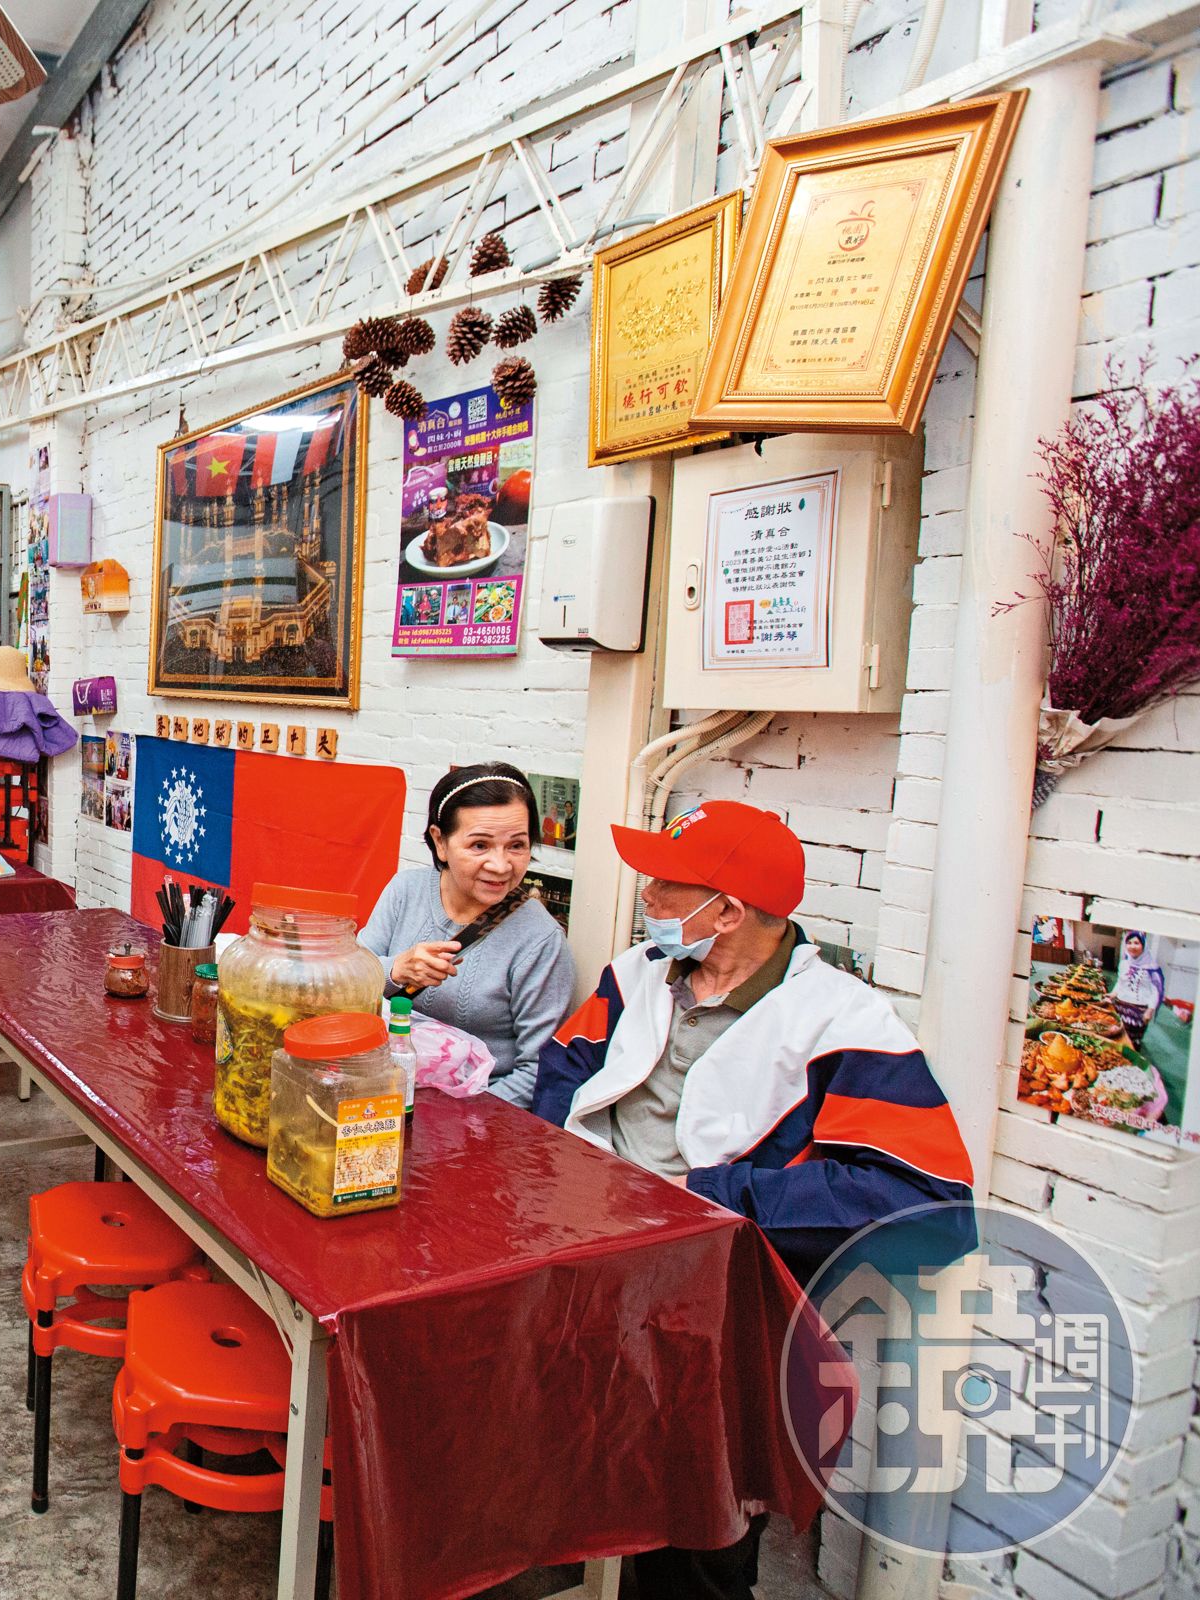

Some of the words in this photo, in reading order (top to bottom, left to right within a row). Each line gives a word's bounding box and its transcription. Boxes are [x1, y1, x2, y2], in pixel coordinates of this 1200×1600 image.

[743, 501, 793, 521] 感謝狀
[750, 526, 792, 541] 清真合
[463, 626, 511, 637] 03-4650085
[462, 634, 511, 645] 0987-385225
